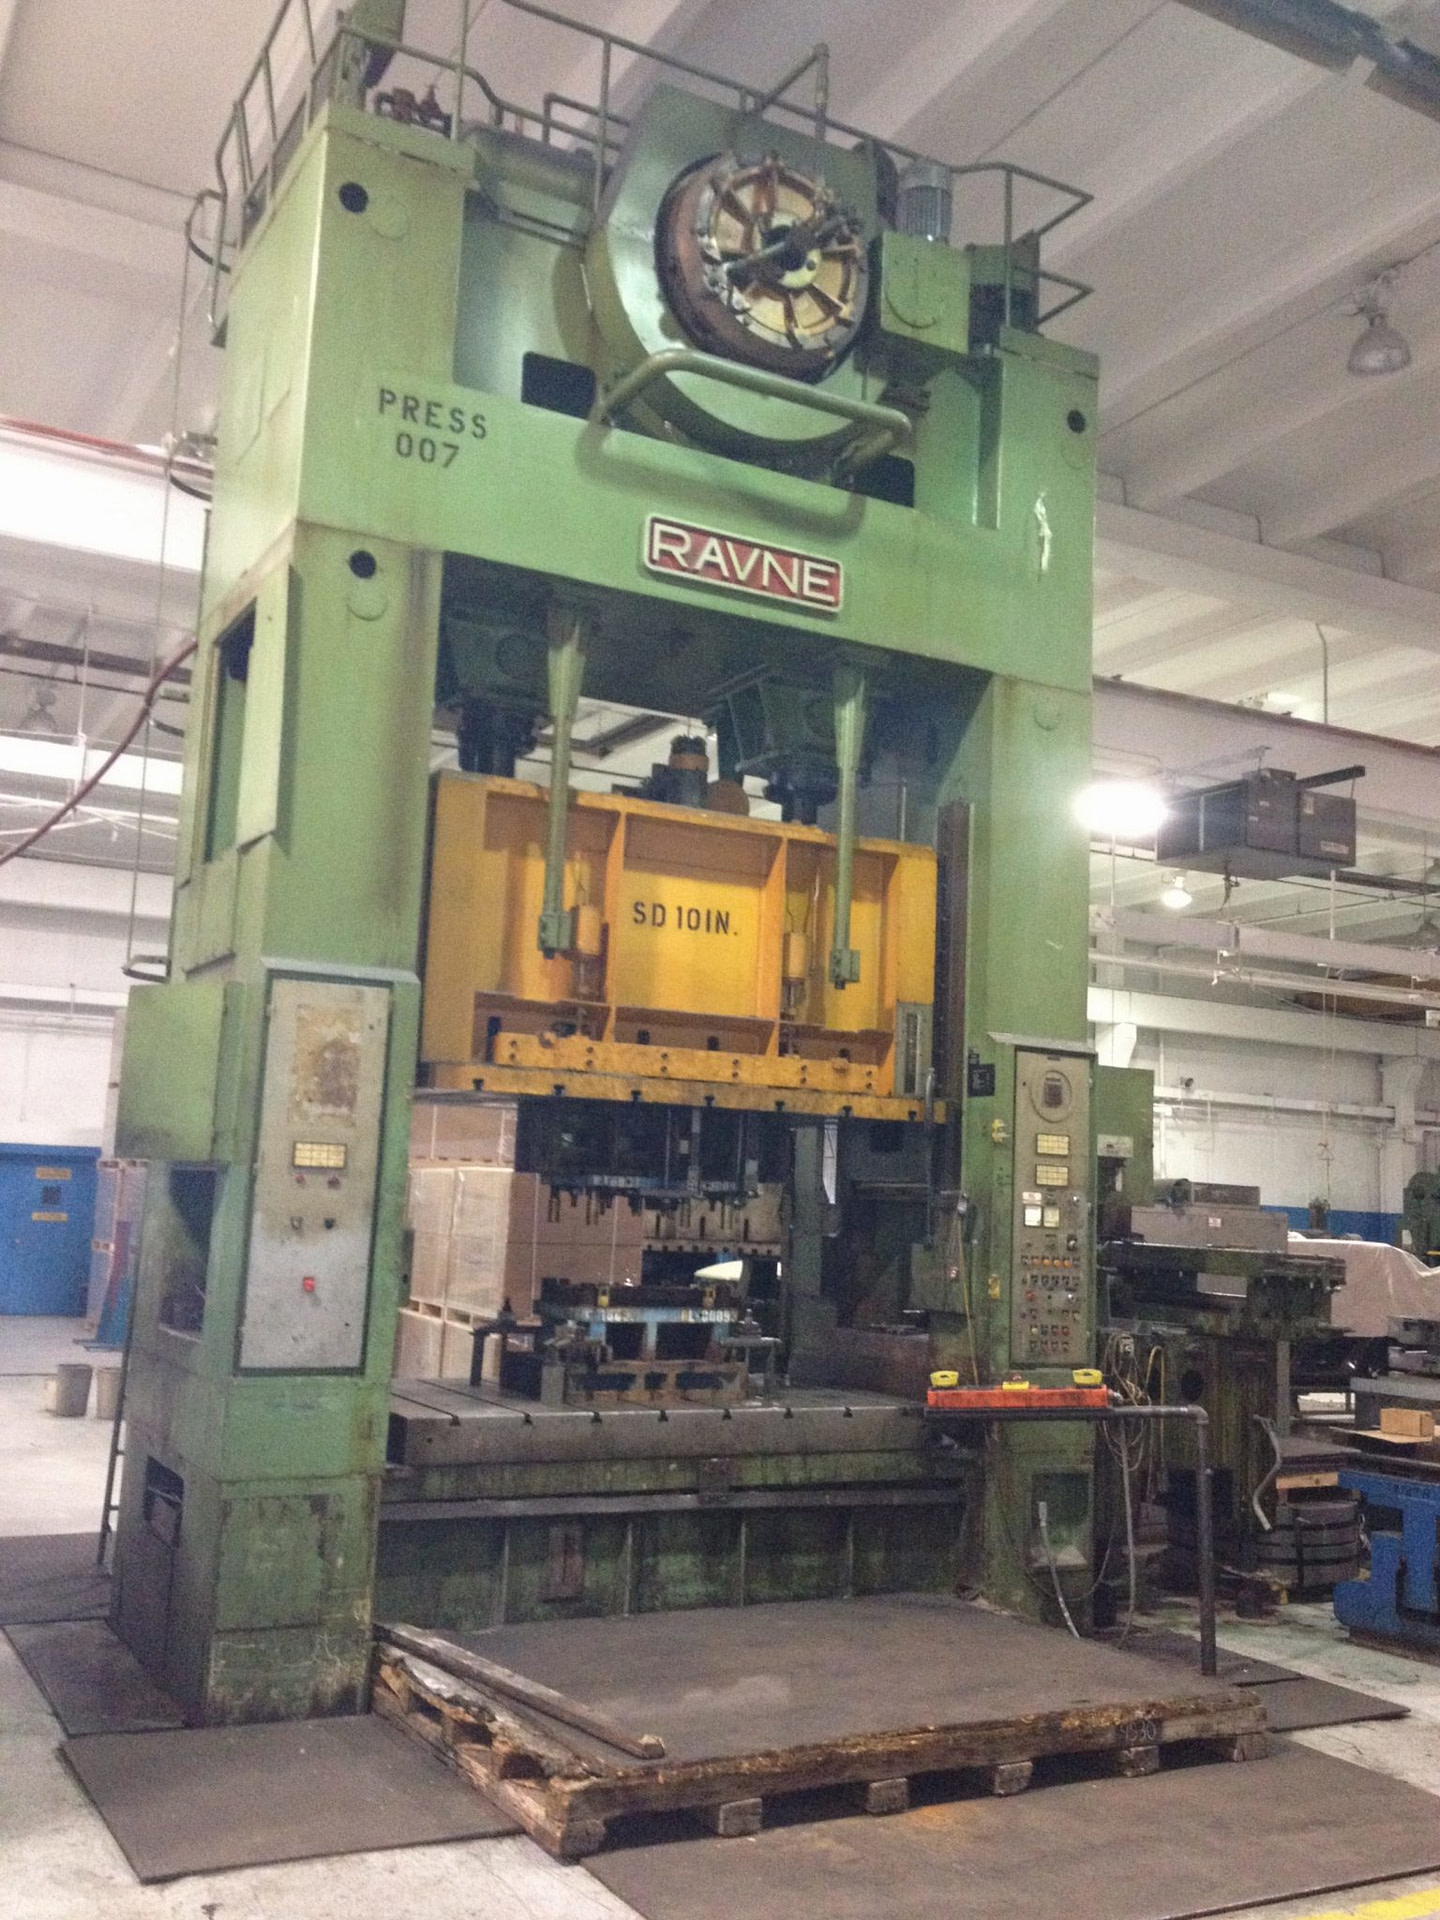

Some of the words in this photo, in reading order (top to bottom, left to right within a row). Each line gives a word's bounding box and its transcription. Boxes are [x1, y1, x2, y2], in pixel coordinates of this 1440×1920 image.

[379, 388, 487, 439] PRESS
[396, 432, 460, 468] 007
[652, 522, 836, 603] RAVNE
[633, 901, 667, 928] SD
